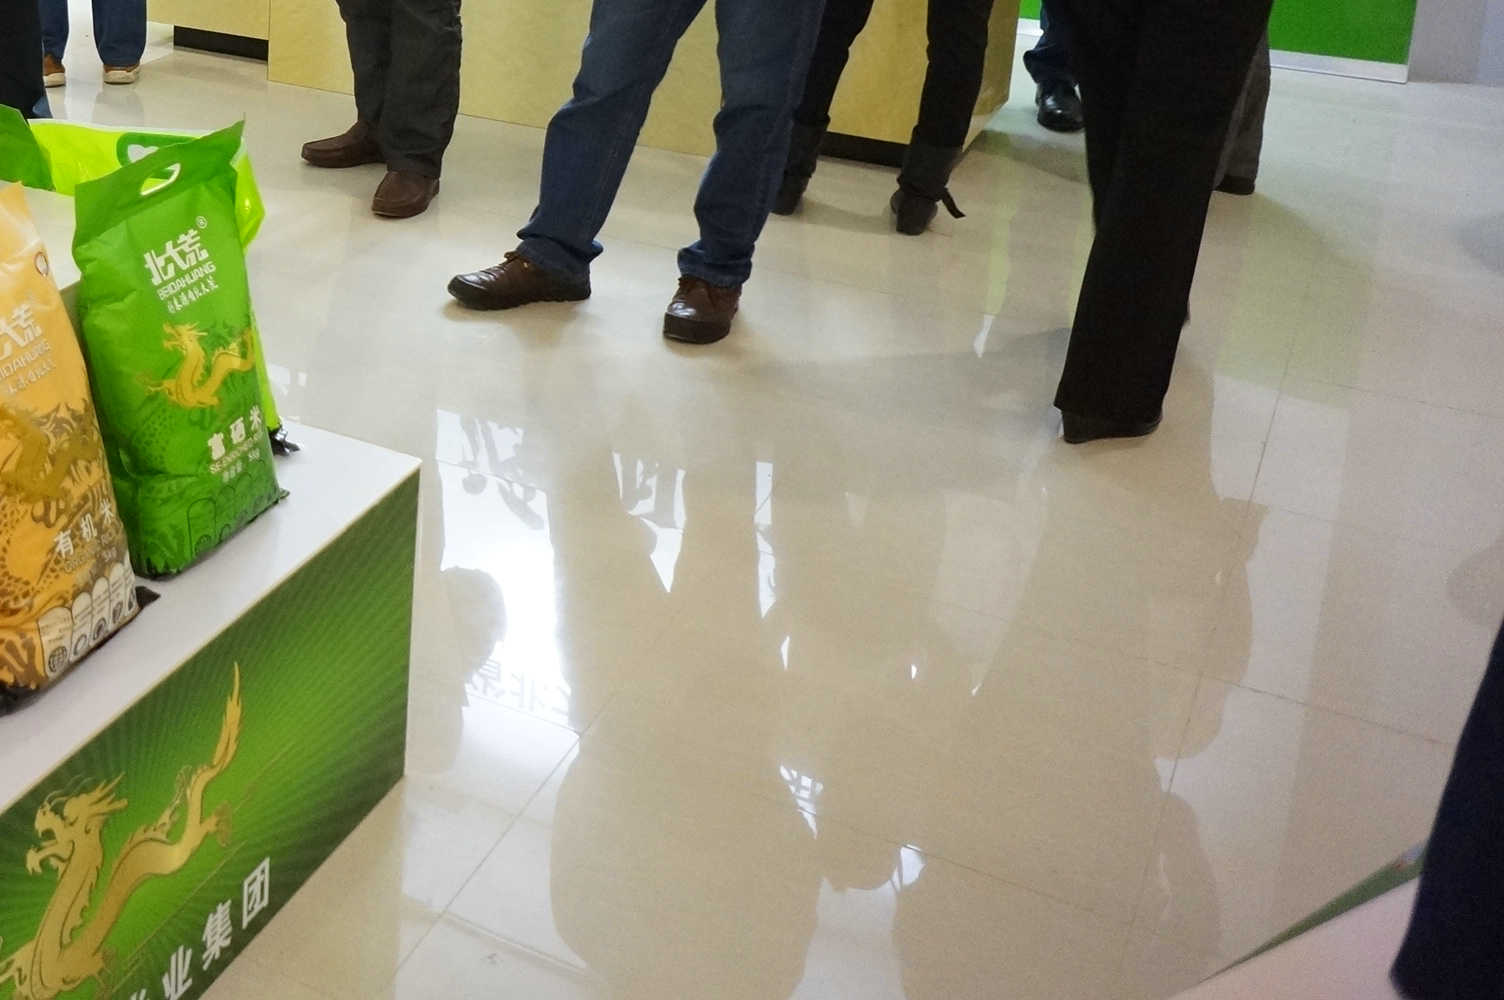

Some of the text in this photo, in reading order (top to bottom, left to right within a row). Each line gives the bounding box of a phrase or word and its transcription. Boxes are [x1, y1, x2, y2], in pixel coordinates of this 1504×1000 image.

[144, 229, 209, 286] 北大荒
[54, 499, 113, 559] 有机米
[130, 856, 271, 1000] 业集团
